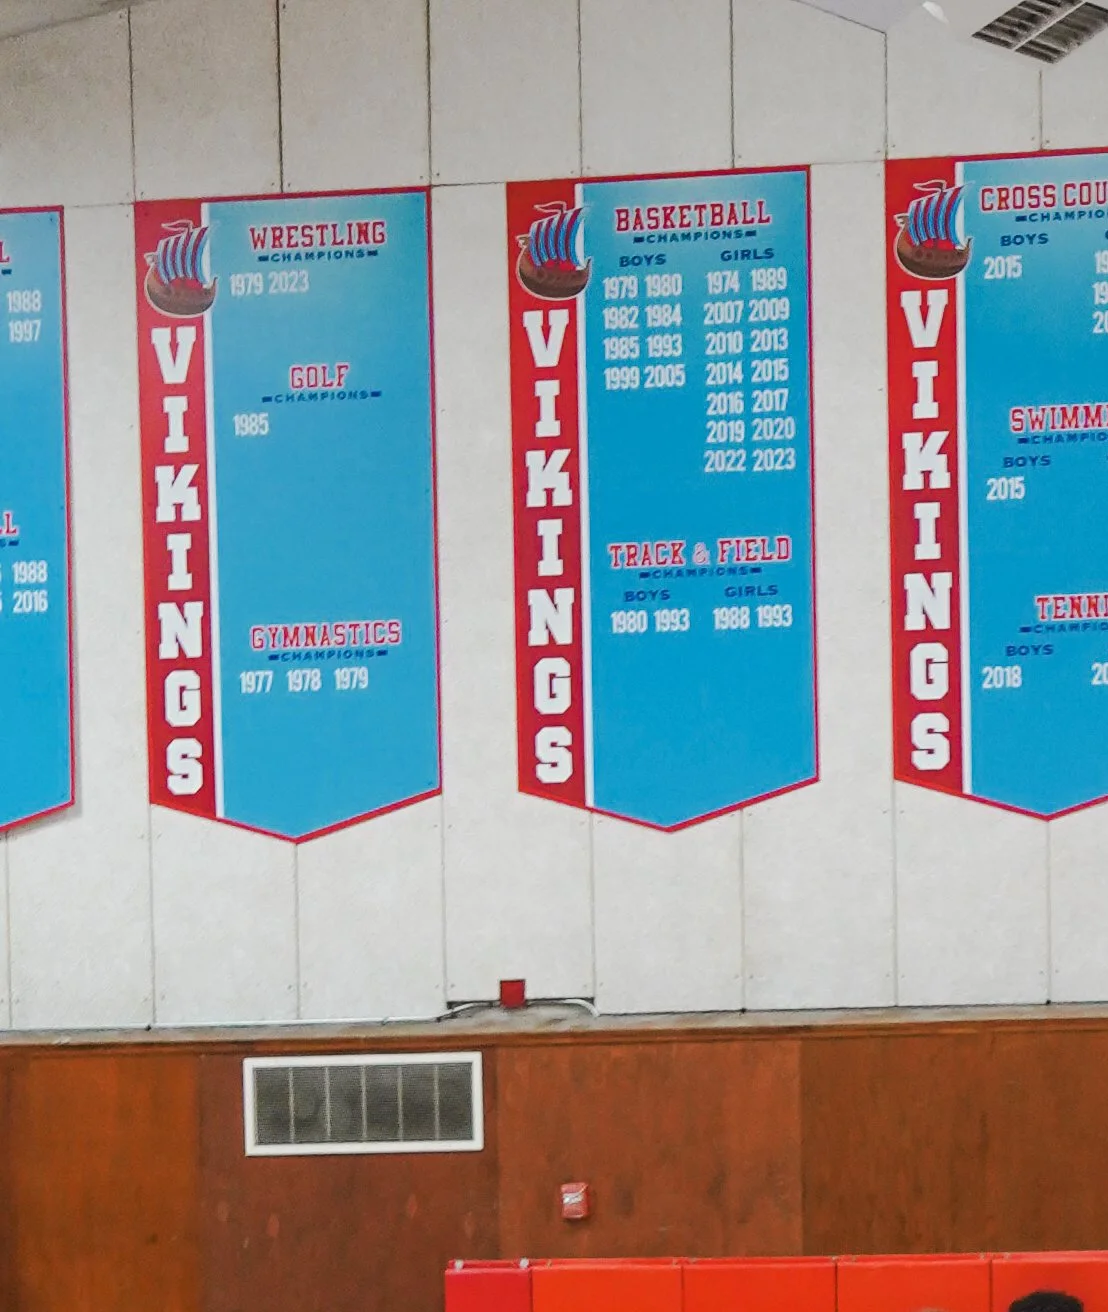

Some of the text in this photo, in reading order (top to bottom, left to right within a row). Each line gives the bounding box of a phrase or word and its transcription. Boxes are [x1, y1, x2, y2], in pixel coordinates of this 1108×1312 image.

[981, 184, 1056, 212] CROSS
[615, 200, 771, 232] BASKETBALL
[250, 221, 387, 249] WRESTLING
[646, 230, 743, 243] CHAMPIONS
[1001, 233, 1049, 246] BOYS
[619, 254, 666, 267] BOYS
[721, 248, 774, 262] GIRLS
[984, 256, 1022, 279] 2015
[230, 271, 309, 296] 1979 2023
[603, 274, 683, 299] 1979 1980
[706, 267, 787, 293] 1974 1989
[6, 291, 41, 313] 1988
[704, 298, 790, 325] 2007 2009
[603, 304, 682, 329] 1982 1984
[9, 320, 41, 342] 1997
[705, 328, 788, 355] 2010 2013
[603, 334, 683, 360] 1985 1993
[290, 364, 349, 389] GOLF
[604, 364, 685, 390] 1999 2005
[706, 358, 789, 385] 2014 2015
[706, 388, 788, 415] 2016 2017
[233, 413, 269, 436] 1985
[706, 417, 795, 443] 2019 2020
[704, 448, 795, 472] 2022 2023
[1003, 455, 1051, 468] BOYS
[986, 477, 1025, 500] 2015
[900, 289, 952, 770] VIKINGS
[522, 309, 575, 784] VIKINGS
[608, 536, 792, 569] TRACK & FIELD
[13, 562, 47, 583] 1988
[151, 326, 204, 796] VIKINGS
[13, 591, 48, 613] 2016
[624, 589, 670, 602] BOYS
[725, 585, 778, 597] GIRLS
[611, 608, 690, 634] 1980 1993
[713, 604, 792, 629] 1988 1993
[251, 621, 401, 650] GYMNASTICS
[1005, 645, 1054, 656] BOYS
[240, 667, 368, 693] 1977 1978 1979
[982, 666, 1022, 689] 2018
